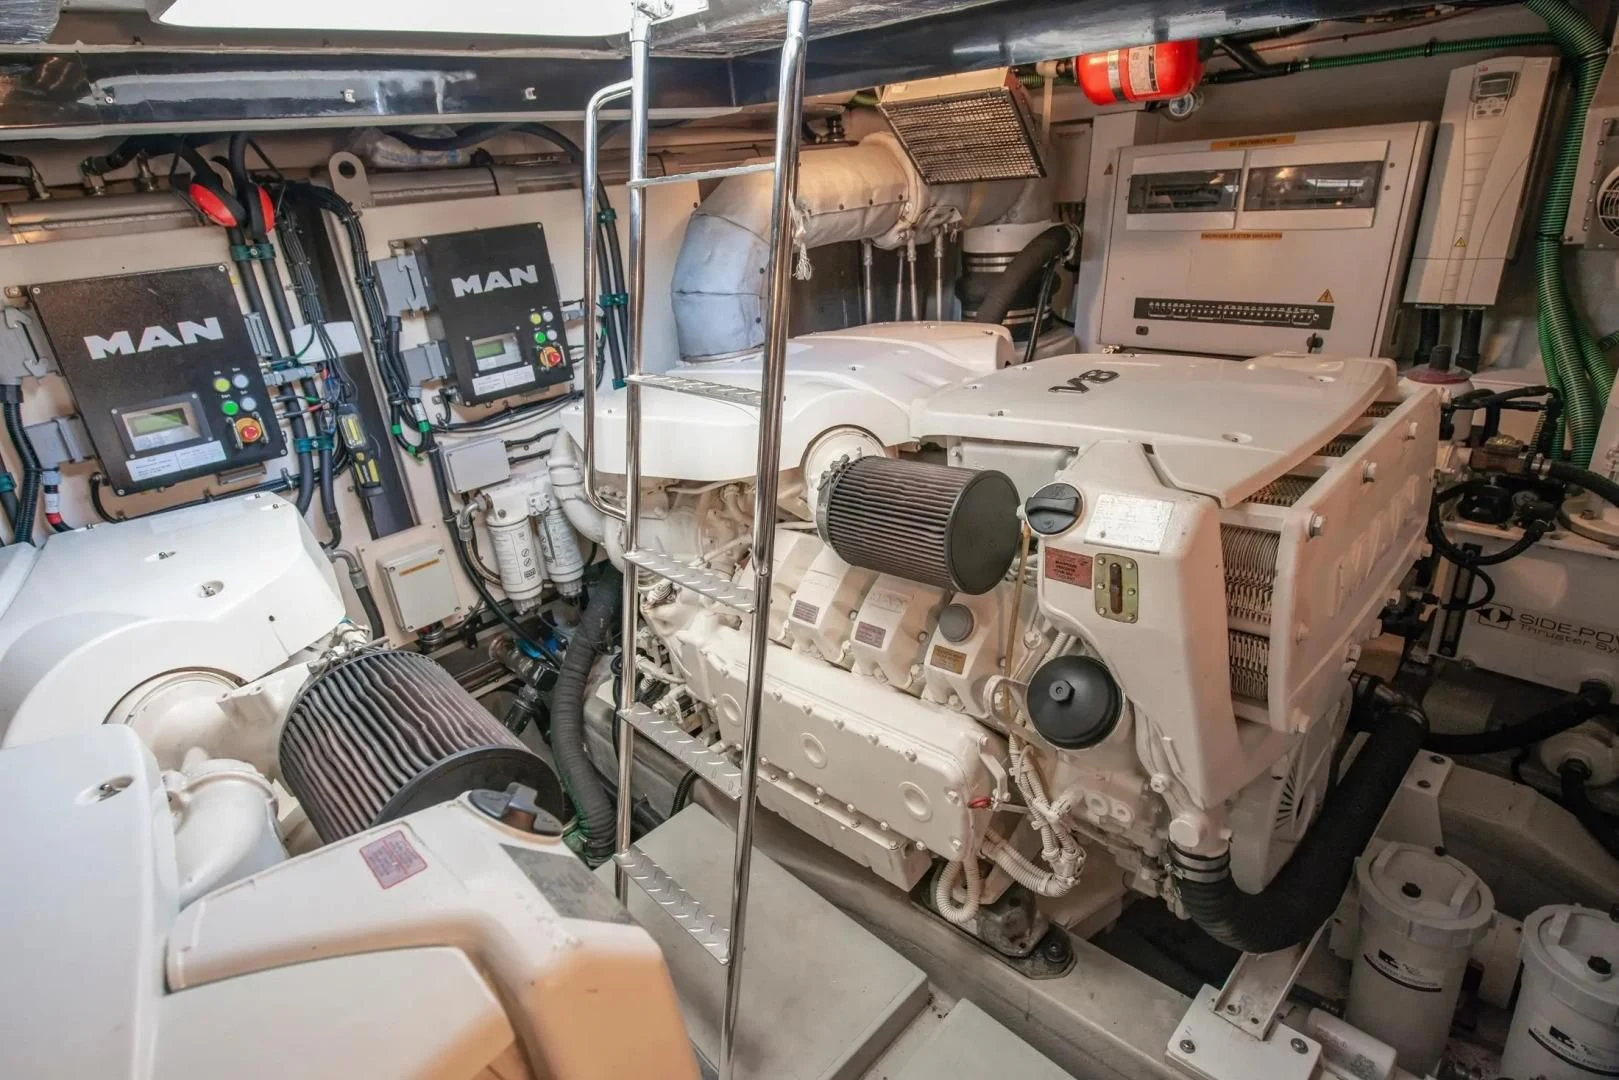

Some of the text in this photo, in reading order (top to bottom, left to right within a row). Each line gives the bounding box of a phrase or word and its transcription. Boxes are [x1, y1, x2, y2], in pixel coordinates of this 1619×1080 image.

[451, 265, 539, 298] MAN
[83, 317, 224, 360] MAN
[1048, 369, 1120, 394] V8
[1520, 624, 1592, 647] Thruster
